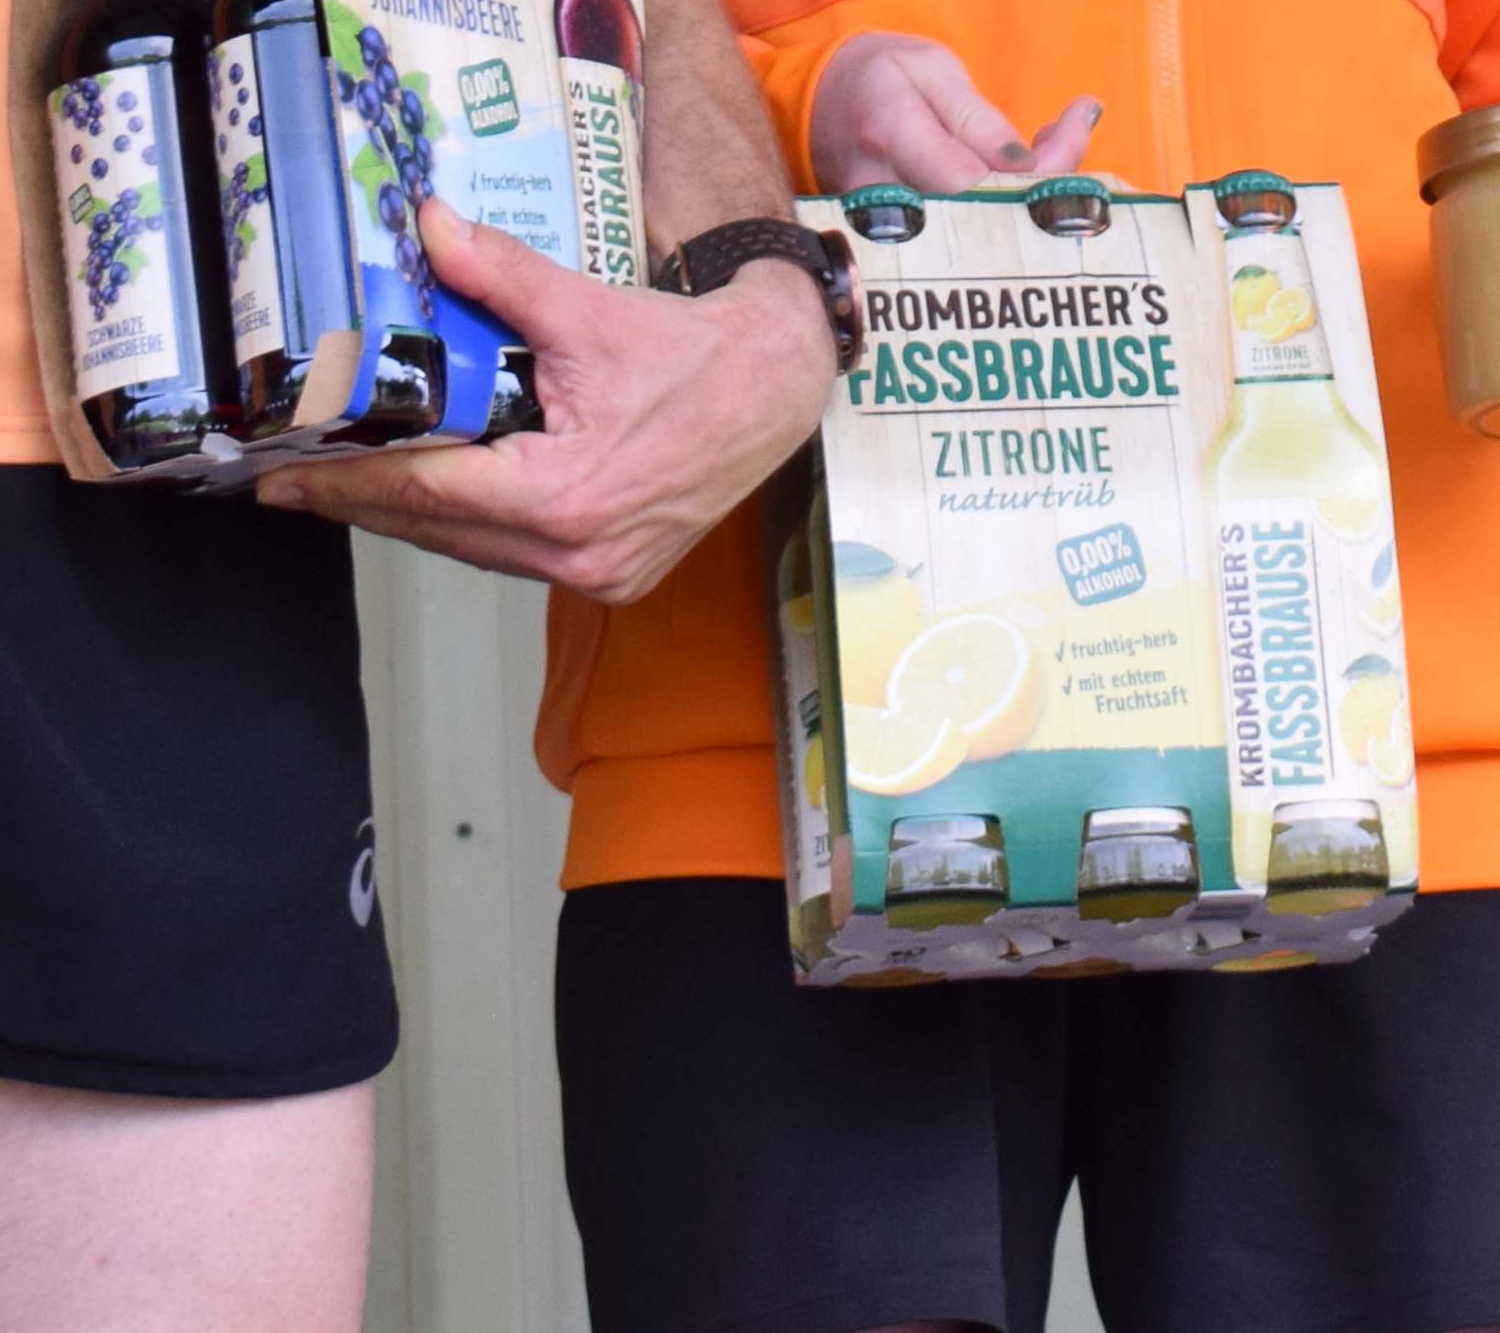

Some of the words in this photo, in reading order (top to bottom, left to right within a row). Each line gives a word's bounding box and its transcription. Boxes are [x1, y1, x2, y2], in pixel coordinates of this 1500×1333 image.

[586, 82, 636, 286] SBRAUSE
[865, 282, 1170, 333] ROMBACHER'S
[1251, 344, 1310, 363] ZITRONE
[930, 426, 1114, 479] ZITRONE
[937, 478, 1117, 513] naturtrüb
[1060, 529, 1133, 578] 0,00%
[1074, 562, 1143, 600] ALKOHOL
[1070, 629, 1179, 660] fruchtig-herb
[1220, 522, 1266, 788] KROMBACHER'S
[1251, 519, 1327, 788] FASSBRAUSE
[1078, 672, 1106, 693] mit
[1111, 668, 1167, 689] echtem
[1094, 685, 1190, 715] Fruchtsaft
